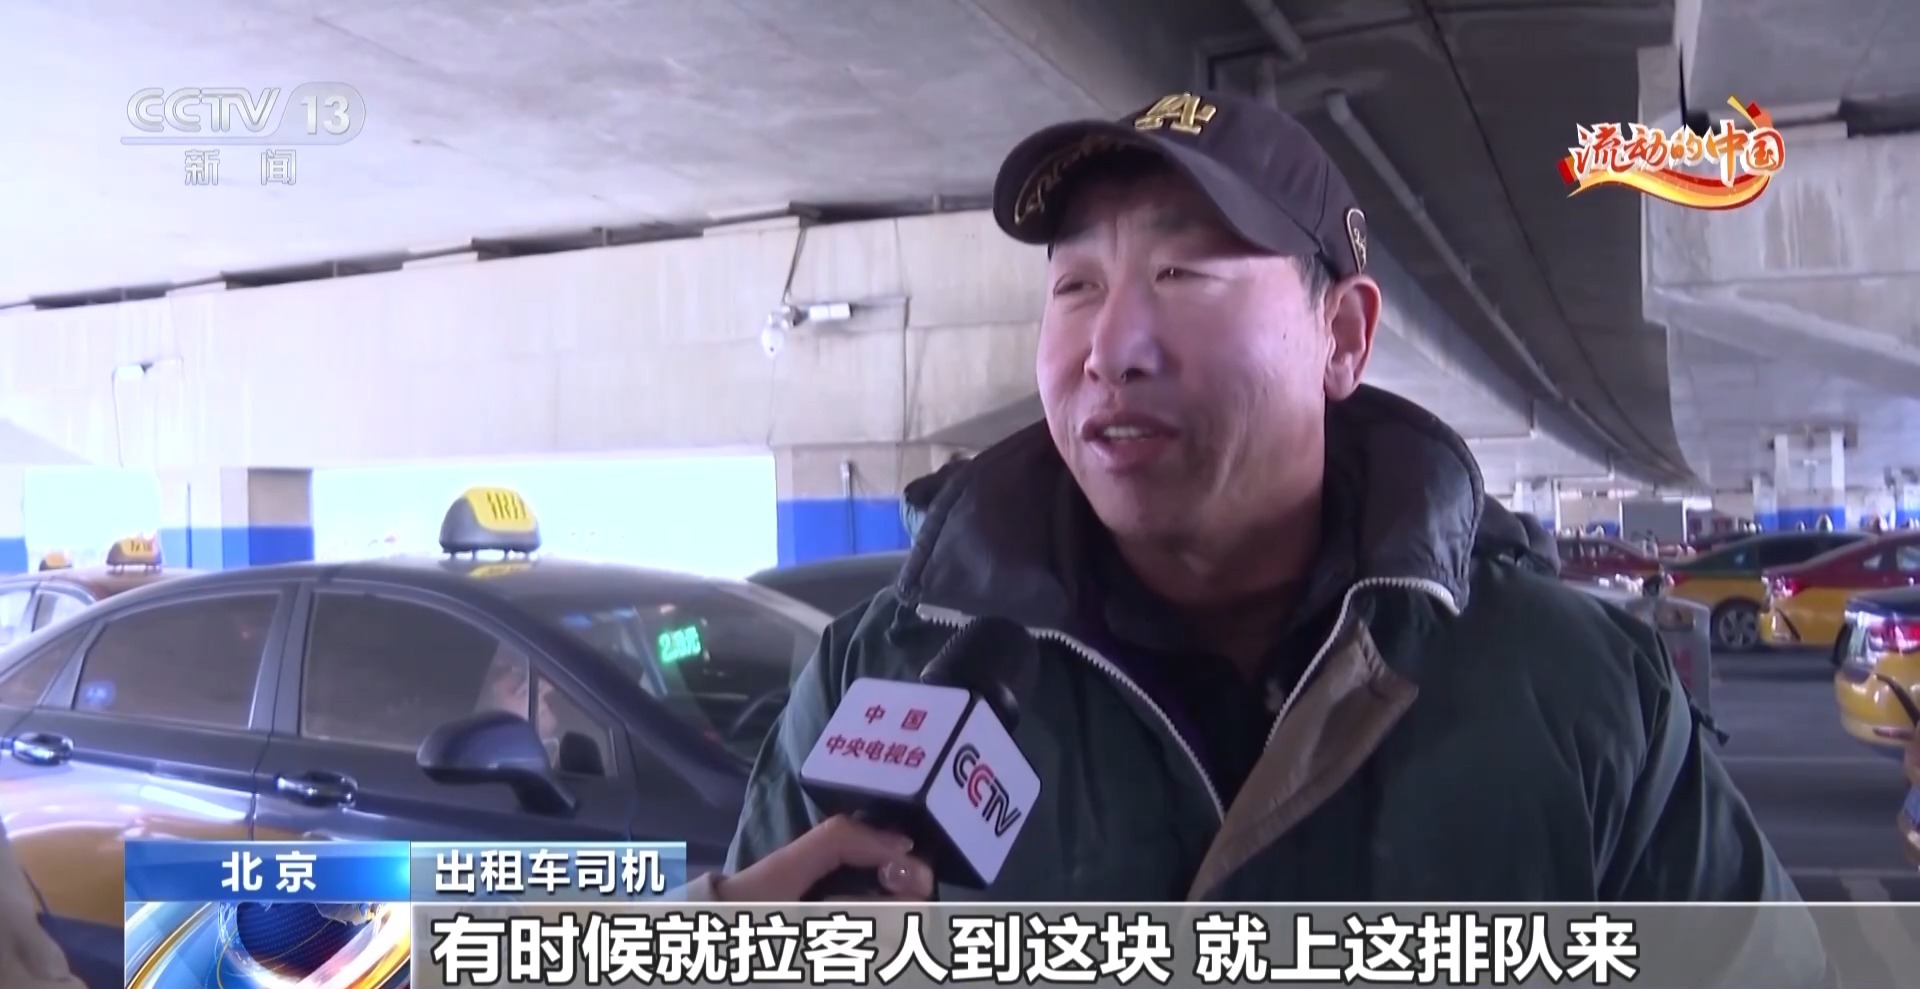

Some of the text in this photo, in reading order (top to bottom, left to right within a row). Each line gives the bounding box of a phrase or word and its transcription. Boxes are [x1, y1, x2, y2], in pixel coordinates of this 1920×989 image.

[865, 704, 927, 731] 中国
[826, 734, 926, 769] 中央电视台
[953, 743, 1021, 838] CCTV
